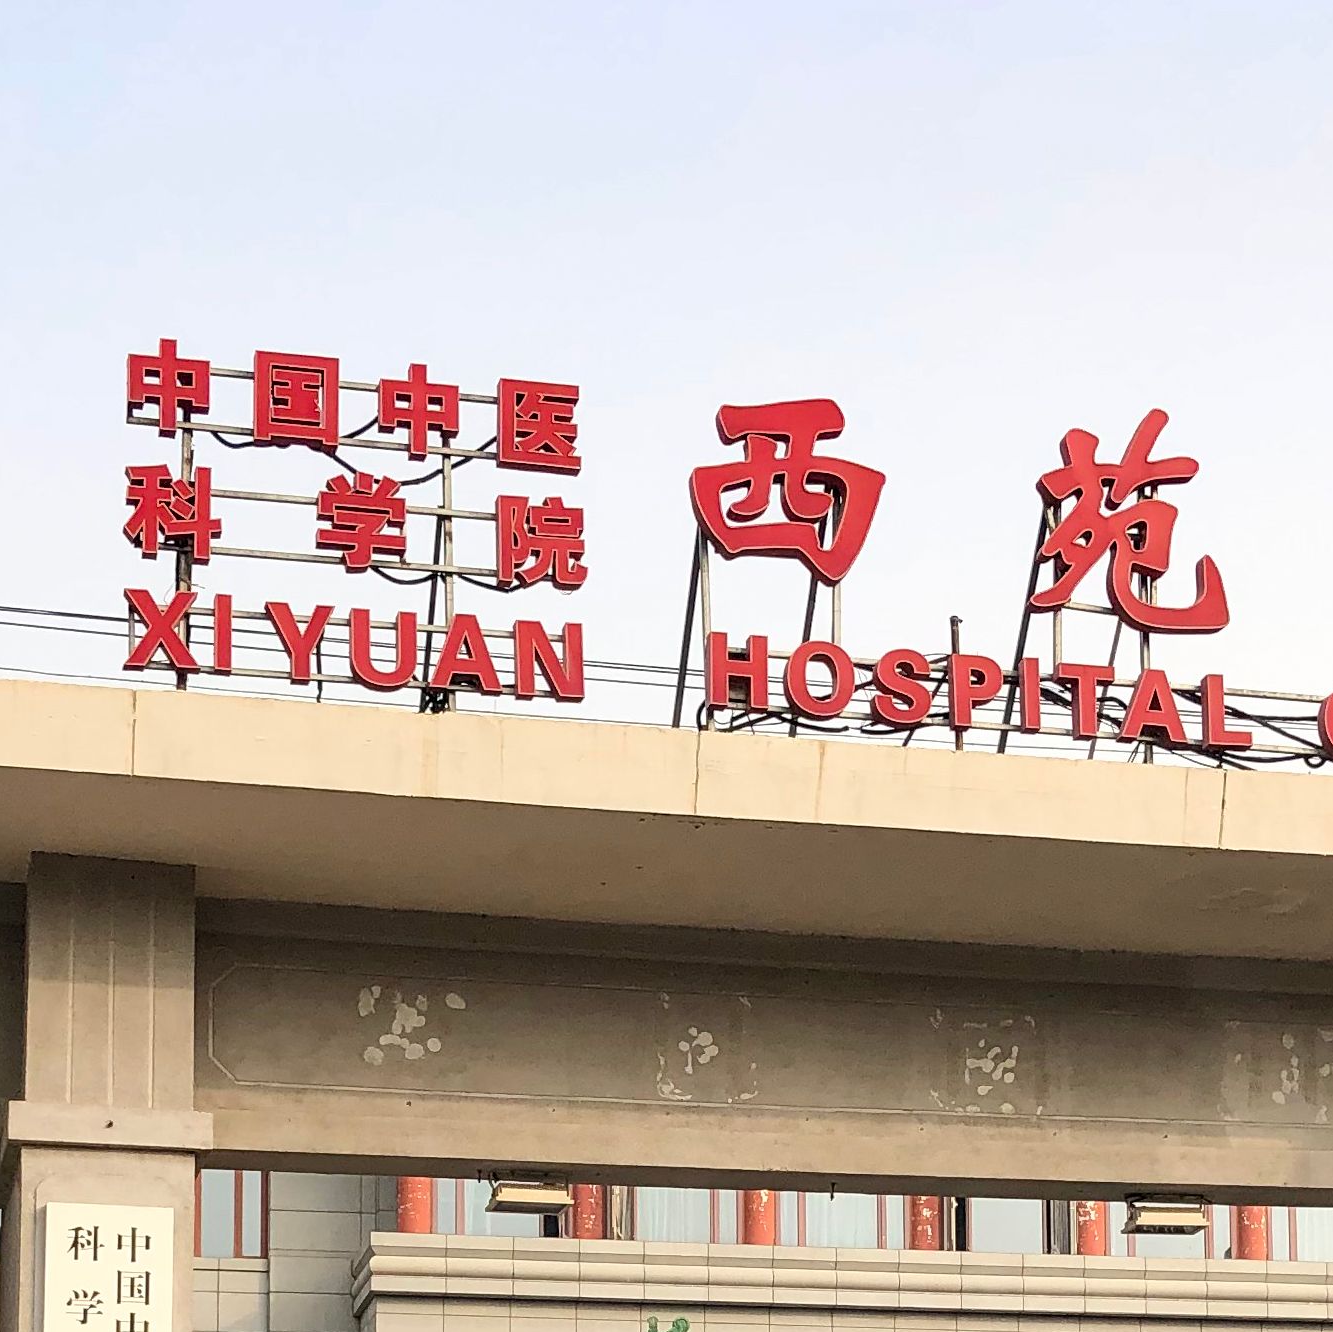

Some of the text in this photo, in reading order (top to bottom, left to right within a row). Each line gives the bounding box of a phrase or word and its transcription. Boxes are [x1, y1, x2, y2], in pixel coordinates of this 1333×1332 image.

[127, 338, 580, 475] 中国中医
[124, 464, 588, 590] 科学院
[123, 587, 586, 703] XIYUAN
[706, 630, 1252, 751] HOSPITAL
